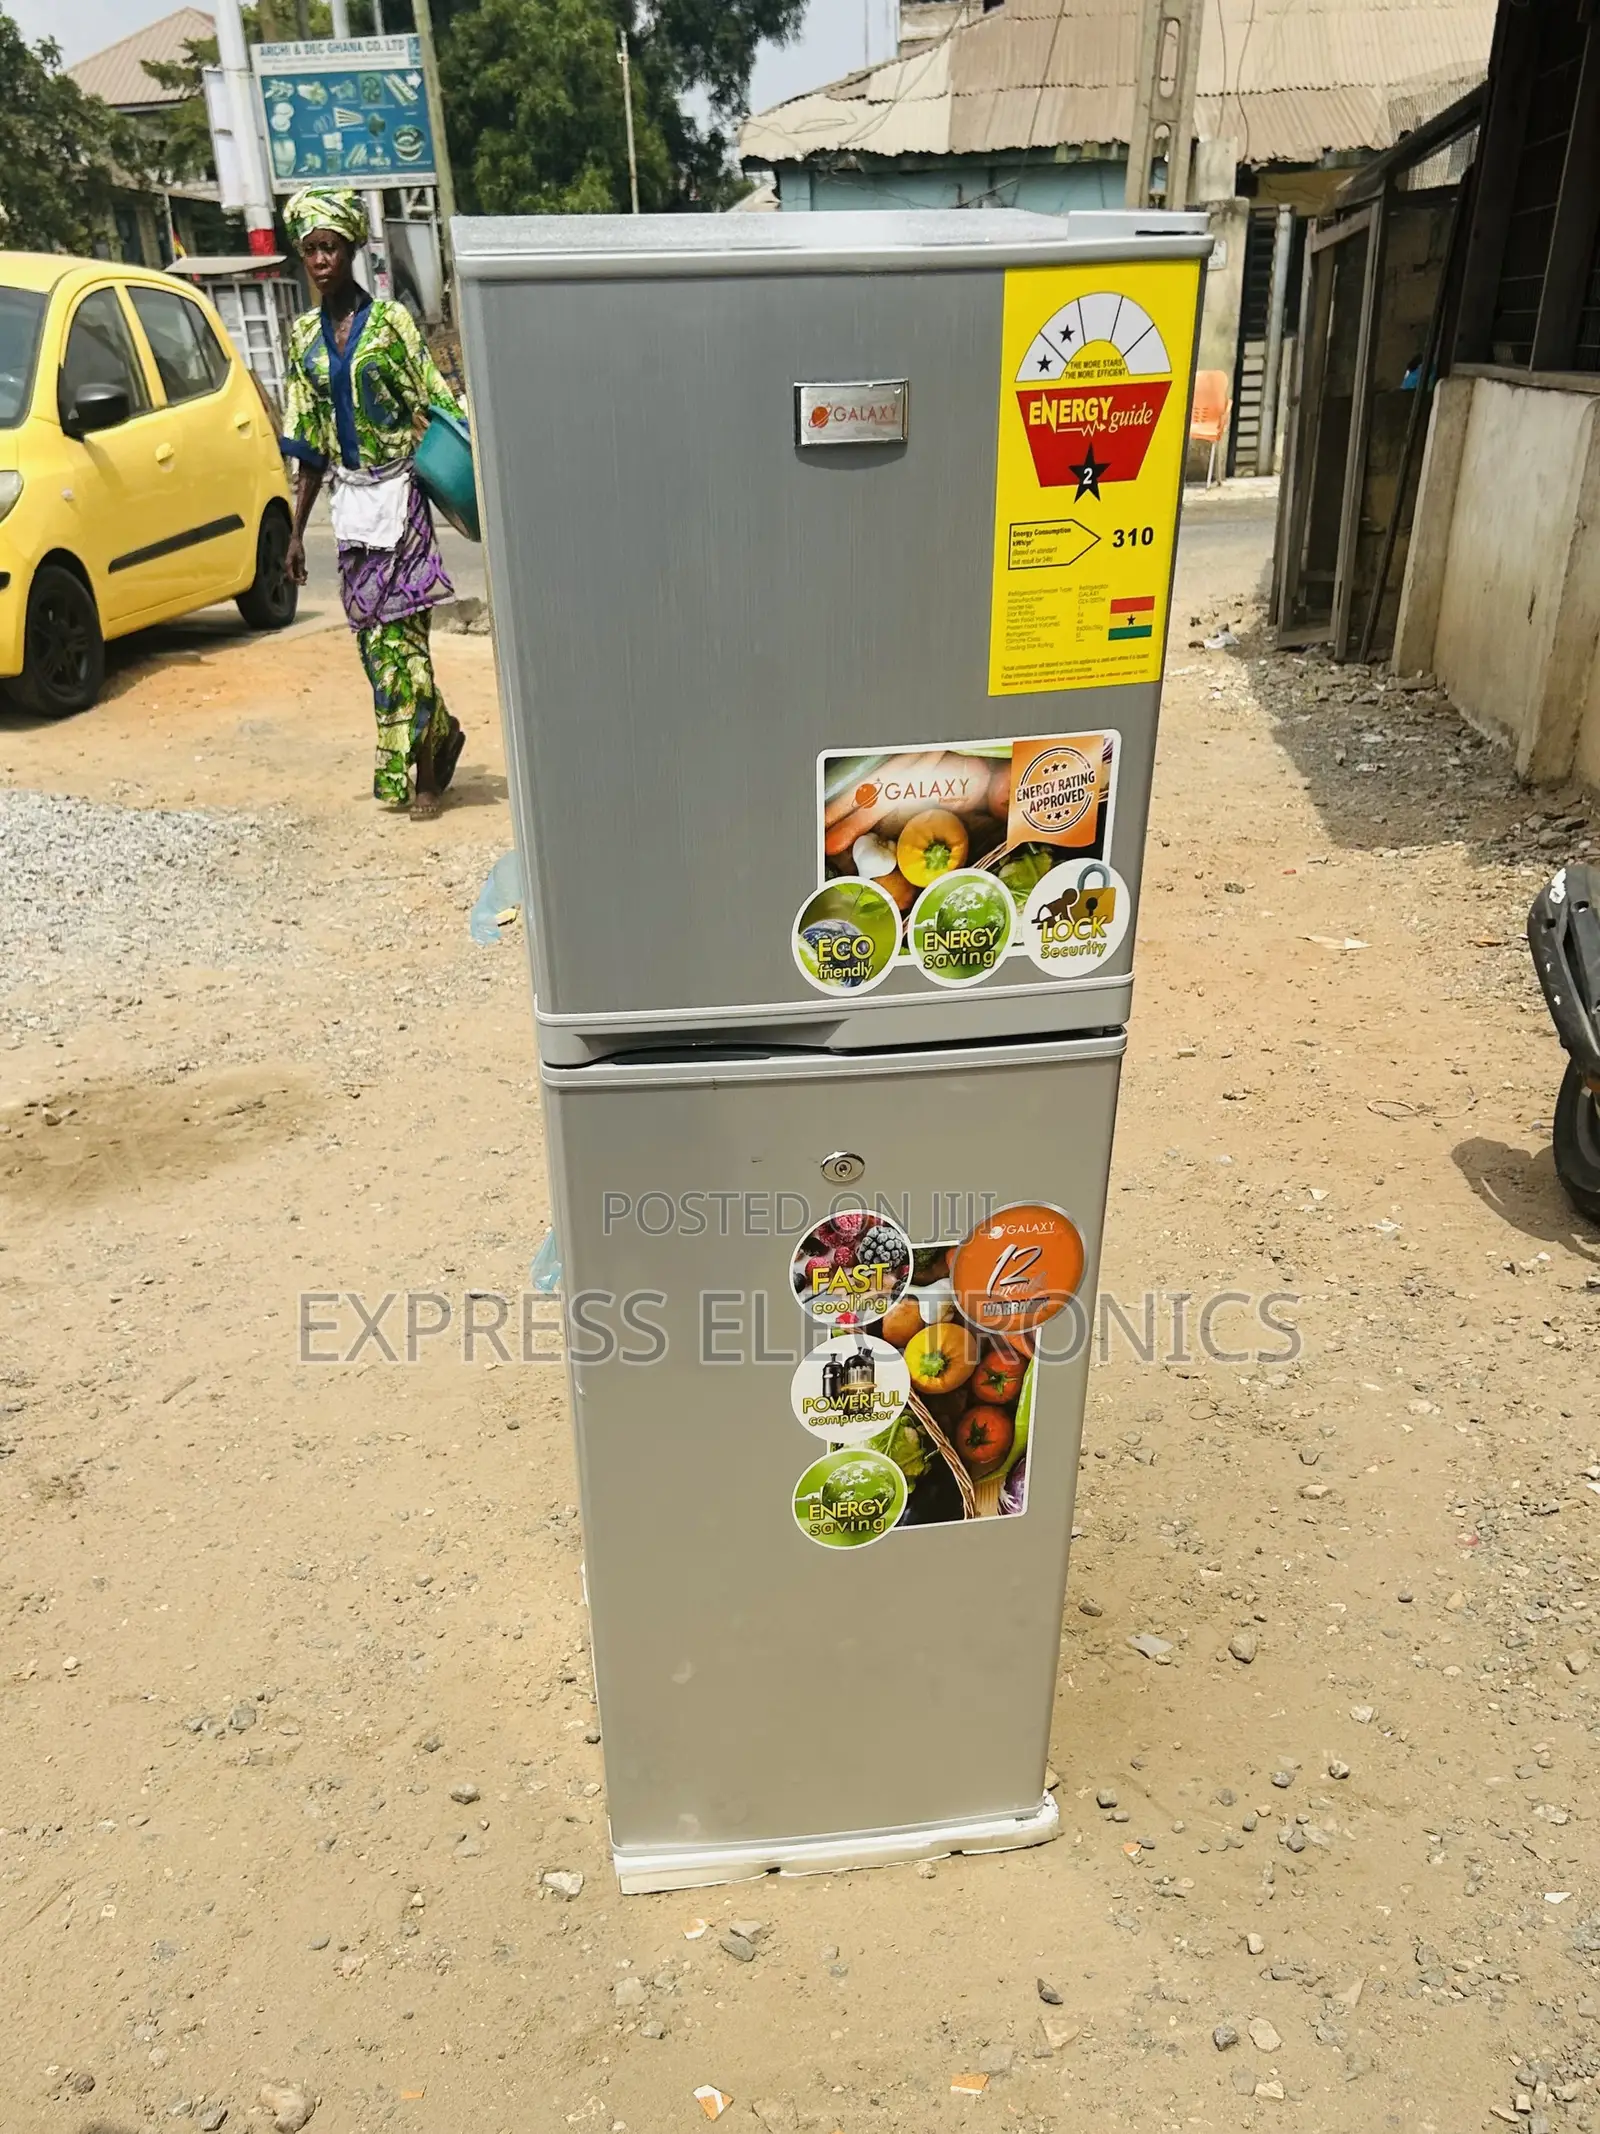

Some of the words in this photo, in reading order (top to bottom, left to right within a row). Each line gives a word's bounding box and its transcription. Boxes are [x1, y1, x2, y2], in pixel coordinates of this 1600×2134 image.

[295, 44, 301, 55] &
[327, 41, 363, 53] GHANA
[366, 40, 384, 51] CO.
[387, 39, 405, 51] LTD
[1065, 371, 1076, 379] THE
[1078, 370, 1094, 378] MORE
[1097, 368, 1126, 378] EFFICIENT
[1071, 361, 1082, 369] THE
[1084, 360, 1101, 368] MORE
[1103, 358, 1123, 368] STARS
[834, 403, 898, 422] GALAXY
[1029, 392, 1113, 434] ENERGY
[1108, 401, 1153, 433] guide
[1083, 467, 1093, 484] 2
[1034, 528, 1072, 536] Consumption
[1112, 526, 1154, 548] 310
[885, 778, 970, 801] GALAXY
[1016, 780, 1055, 802] ENERGY
[1058, 770, 1095, 792] RATING
[1030, 788, 1085, 814] APPROVED
[924, 927, 999, 952] ENERGY
[1041, 916, 1107, 943] LOCK
[817, 935, 874, 963] ECO
[924, 950, 997, 969] saving
[1041, 939, 1107, 959] Security
[818, 963, 873, 981] friendly
[1006, 1221, 1056, 1234] GALAXY
[812, 1262, 891, 1296] FAST
[986, 1244, 1043, 1298] 12
[812, 1295, 888, 1316] cooling
[802, 1390, 903, 1414] POWERFUL
[808, 1410, 894, 1428] compressor
[808, 1497, 890, 1522] ENERGY
[809, 1516, 886, 1536] saving
